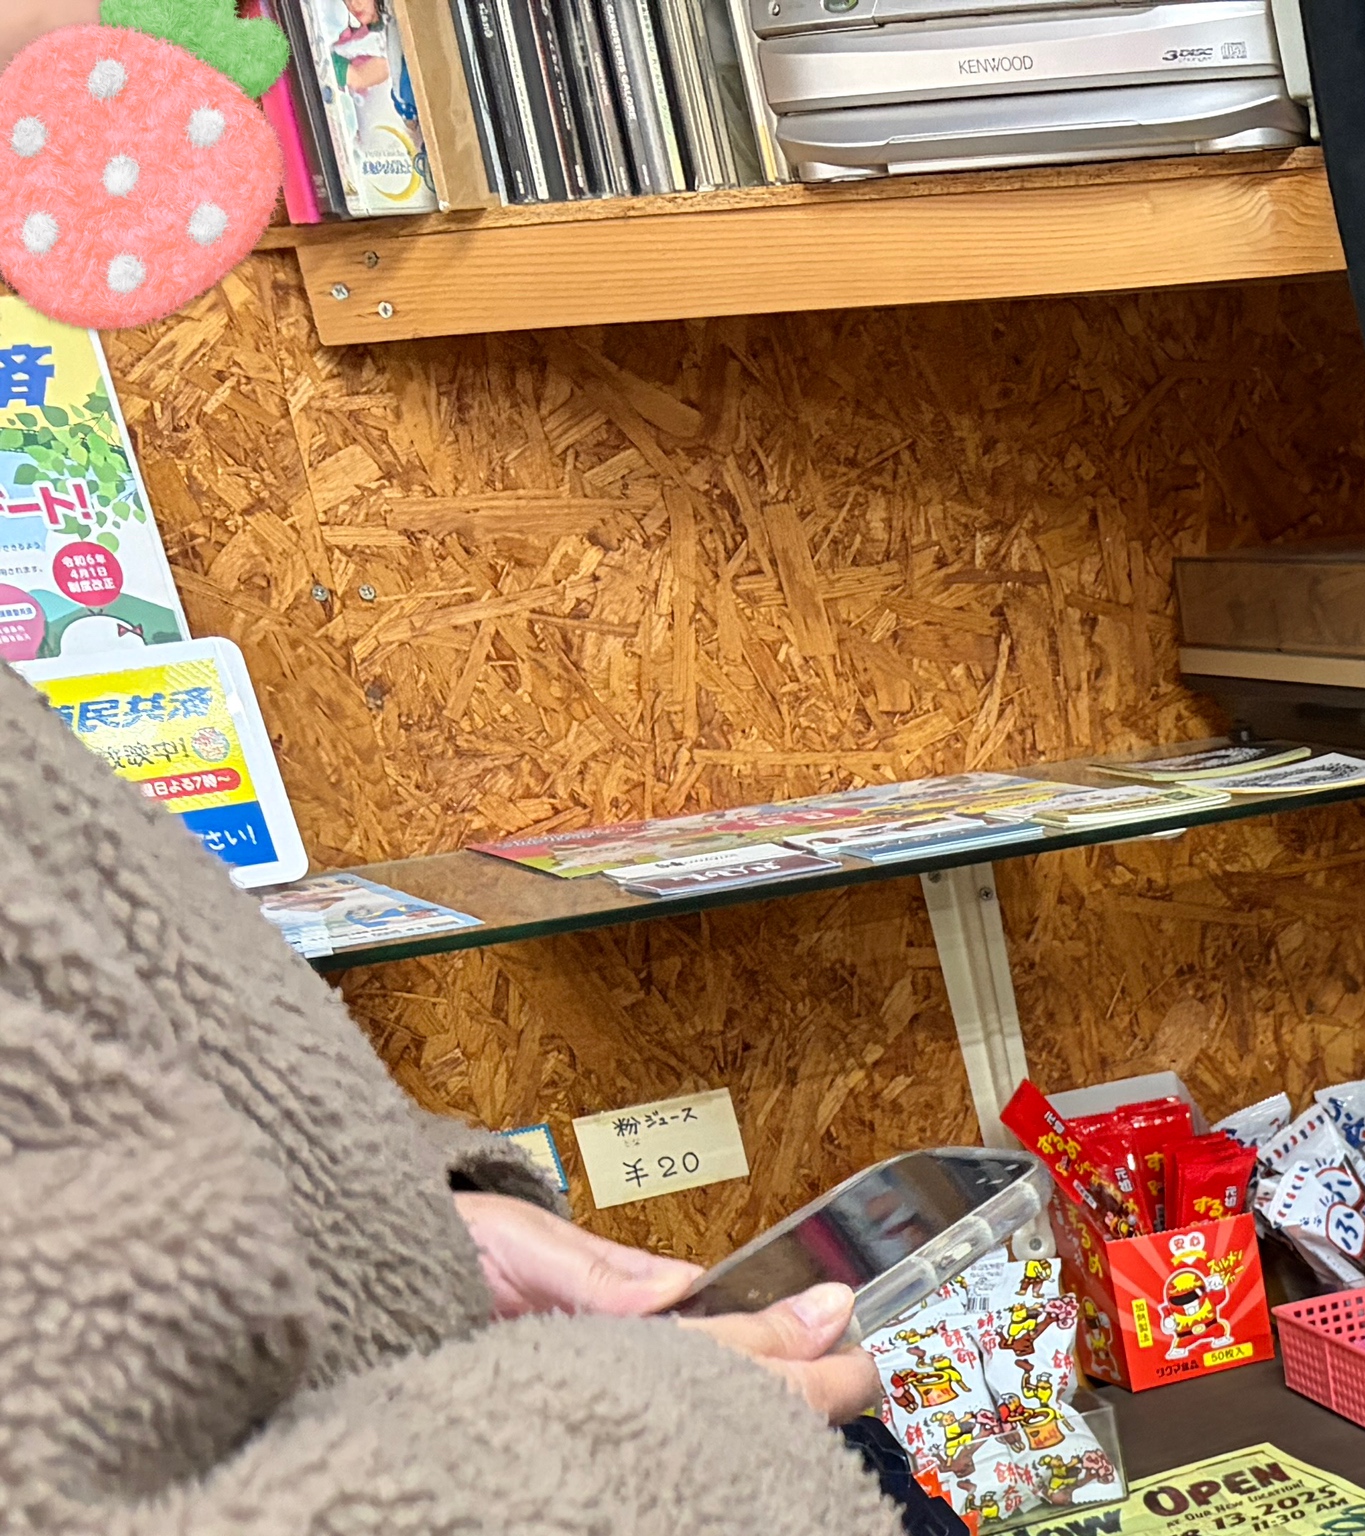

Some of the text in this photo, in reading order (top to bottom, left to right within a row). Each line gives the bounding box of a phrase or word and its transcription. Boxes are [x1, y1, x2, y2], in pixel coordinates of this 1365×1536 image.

[958, 55, 1034, 75] KENWOOD
[0, 482, 93, 525] ート!
[69, 567, 109, 580] 4月1日
[612, 1106, 699, 1138] 粉ジュース
[1172, 1236, 1202, 1251] 安心
[1210, 1346, 1246, 1363] 50枚入
[1142, 1461, 1292, 1518] OPEN
[1251, 1497, 1350, 1533] 11:30 AM
